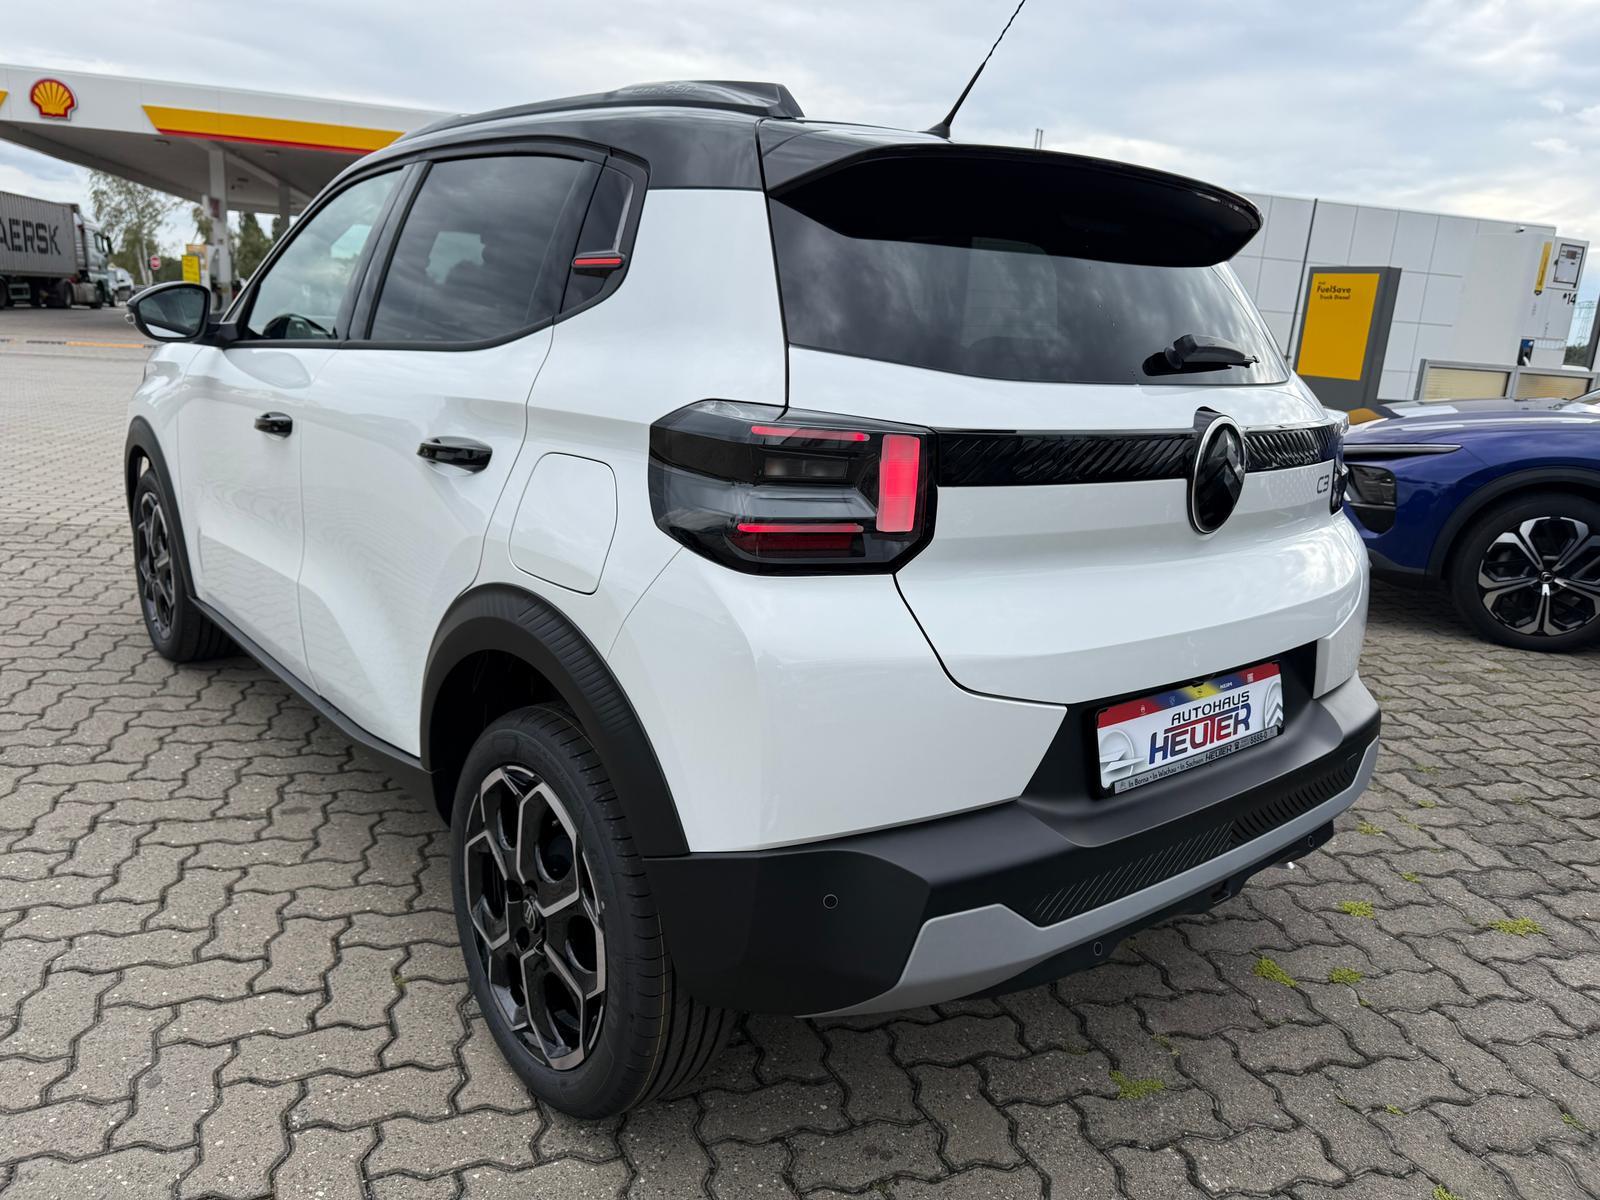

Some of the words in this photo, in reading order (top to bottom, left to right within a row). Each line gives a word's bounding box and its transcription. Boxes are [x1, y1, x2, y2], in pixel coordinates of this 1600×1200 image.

[1317, 285, 1352, 294] FuelSave
[1316, 474, 1330, 494] C3
[1171, 690, 1250, 726] AUTOHAUS
[1148, 703, 1252, 765] HEUTER
[1134, 777, 1150, 787] Borna
[1157, 766, 1177, 779] Wachau
[1185, 756, 1204, 769] Sachsen
